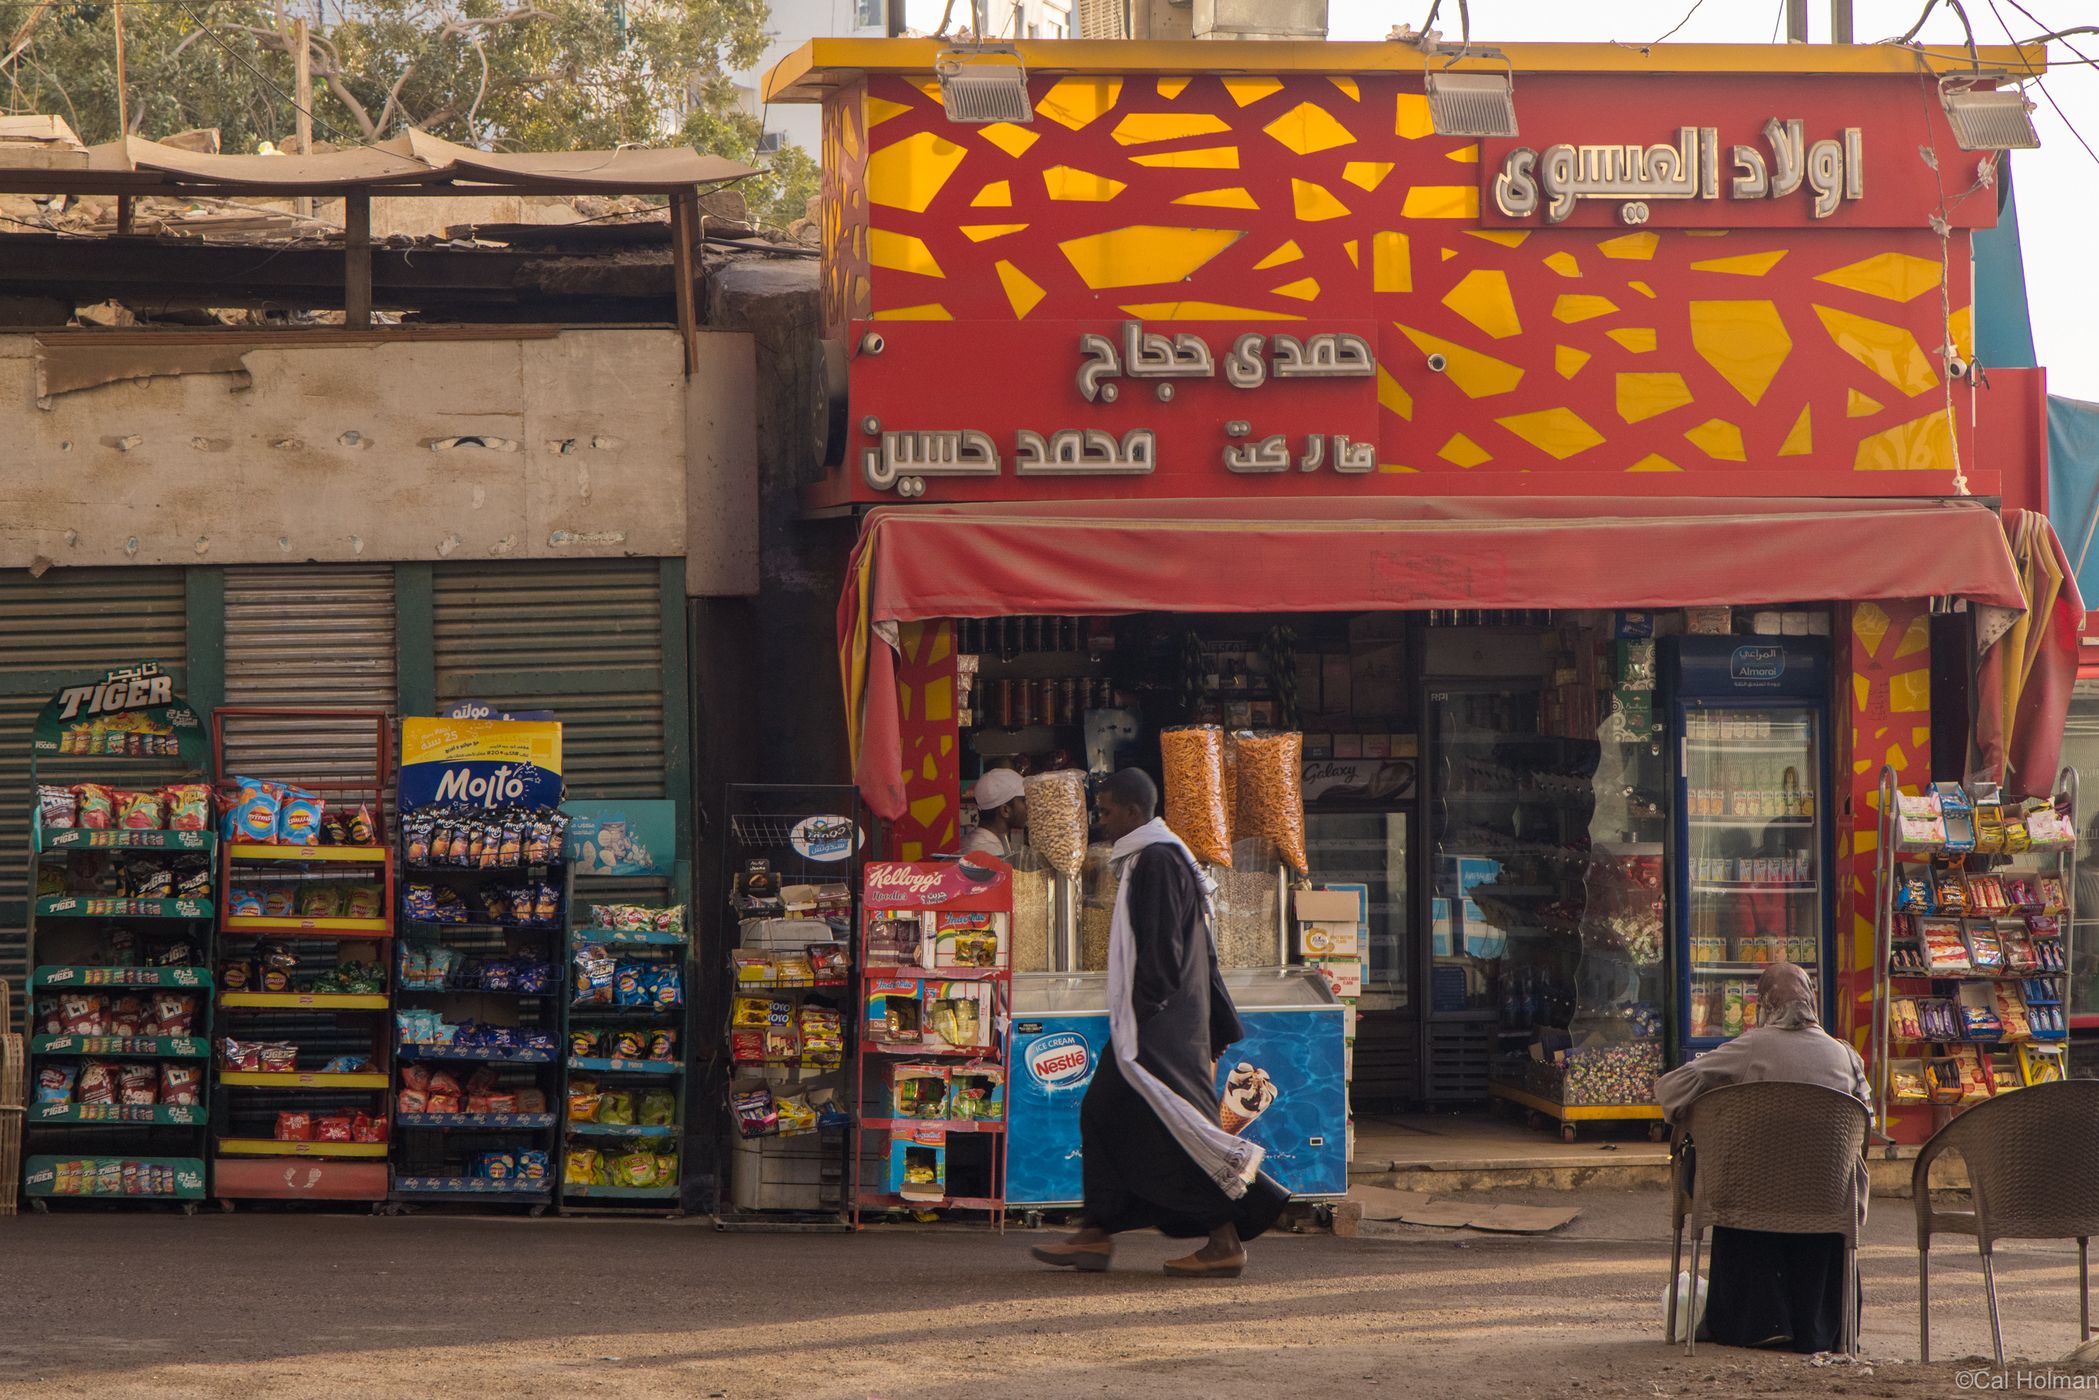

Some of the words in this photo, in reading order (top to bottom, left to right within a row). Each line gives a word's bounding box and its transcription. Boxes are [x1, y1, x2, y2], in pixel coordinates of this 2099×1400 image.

[1493, 127, 1718, 225] العيسوى
[1733, 117, 1863, 219] اولاد
[1077, 320, 1214, 402] حجاج
[1223, 332, 1376, 390] حمدى
[861, 415, 1001, 497] حسين
[1014, 428, 1156, 476] محمد
[102, 662, 158, 685] تايجر
[1739, 666, 1777, 676] Almarai
[58, 675, 172, 721] TIGER
[1303, 762, 1359, 784] Galaxy
[435, 765, 523, 809] Molto
[52, 832, 80, 846] TIGER
[869, 865, 943, 893] Kellogg's
[49, 900, 76, 913] TIGER
[47, 970, 74, 984] TIGER
[45, 1038, 72, 1052] TIGER
[1035, 1043, 1046, 1053] ICE
[1048, 1036, 1076, 1047] CREAM
[42, 1104, 70, 1118] TIGER
[25, 1171, 54, 1185] TIGER
